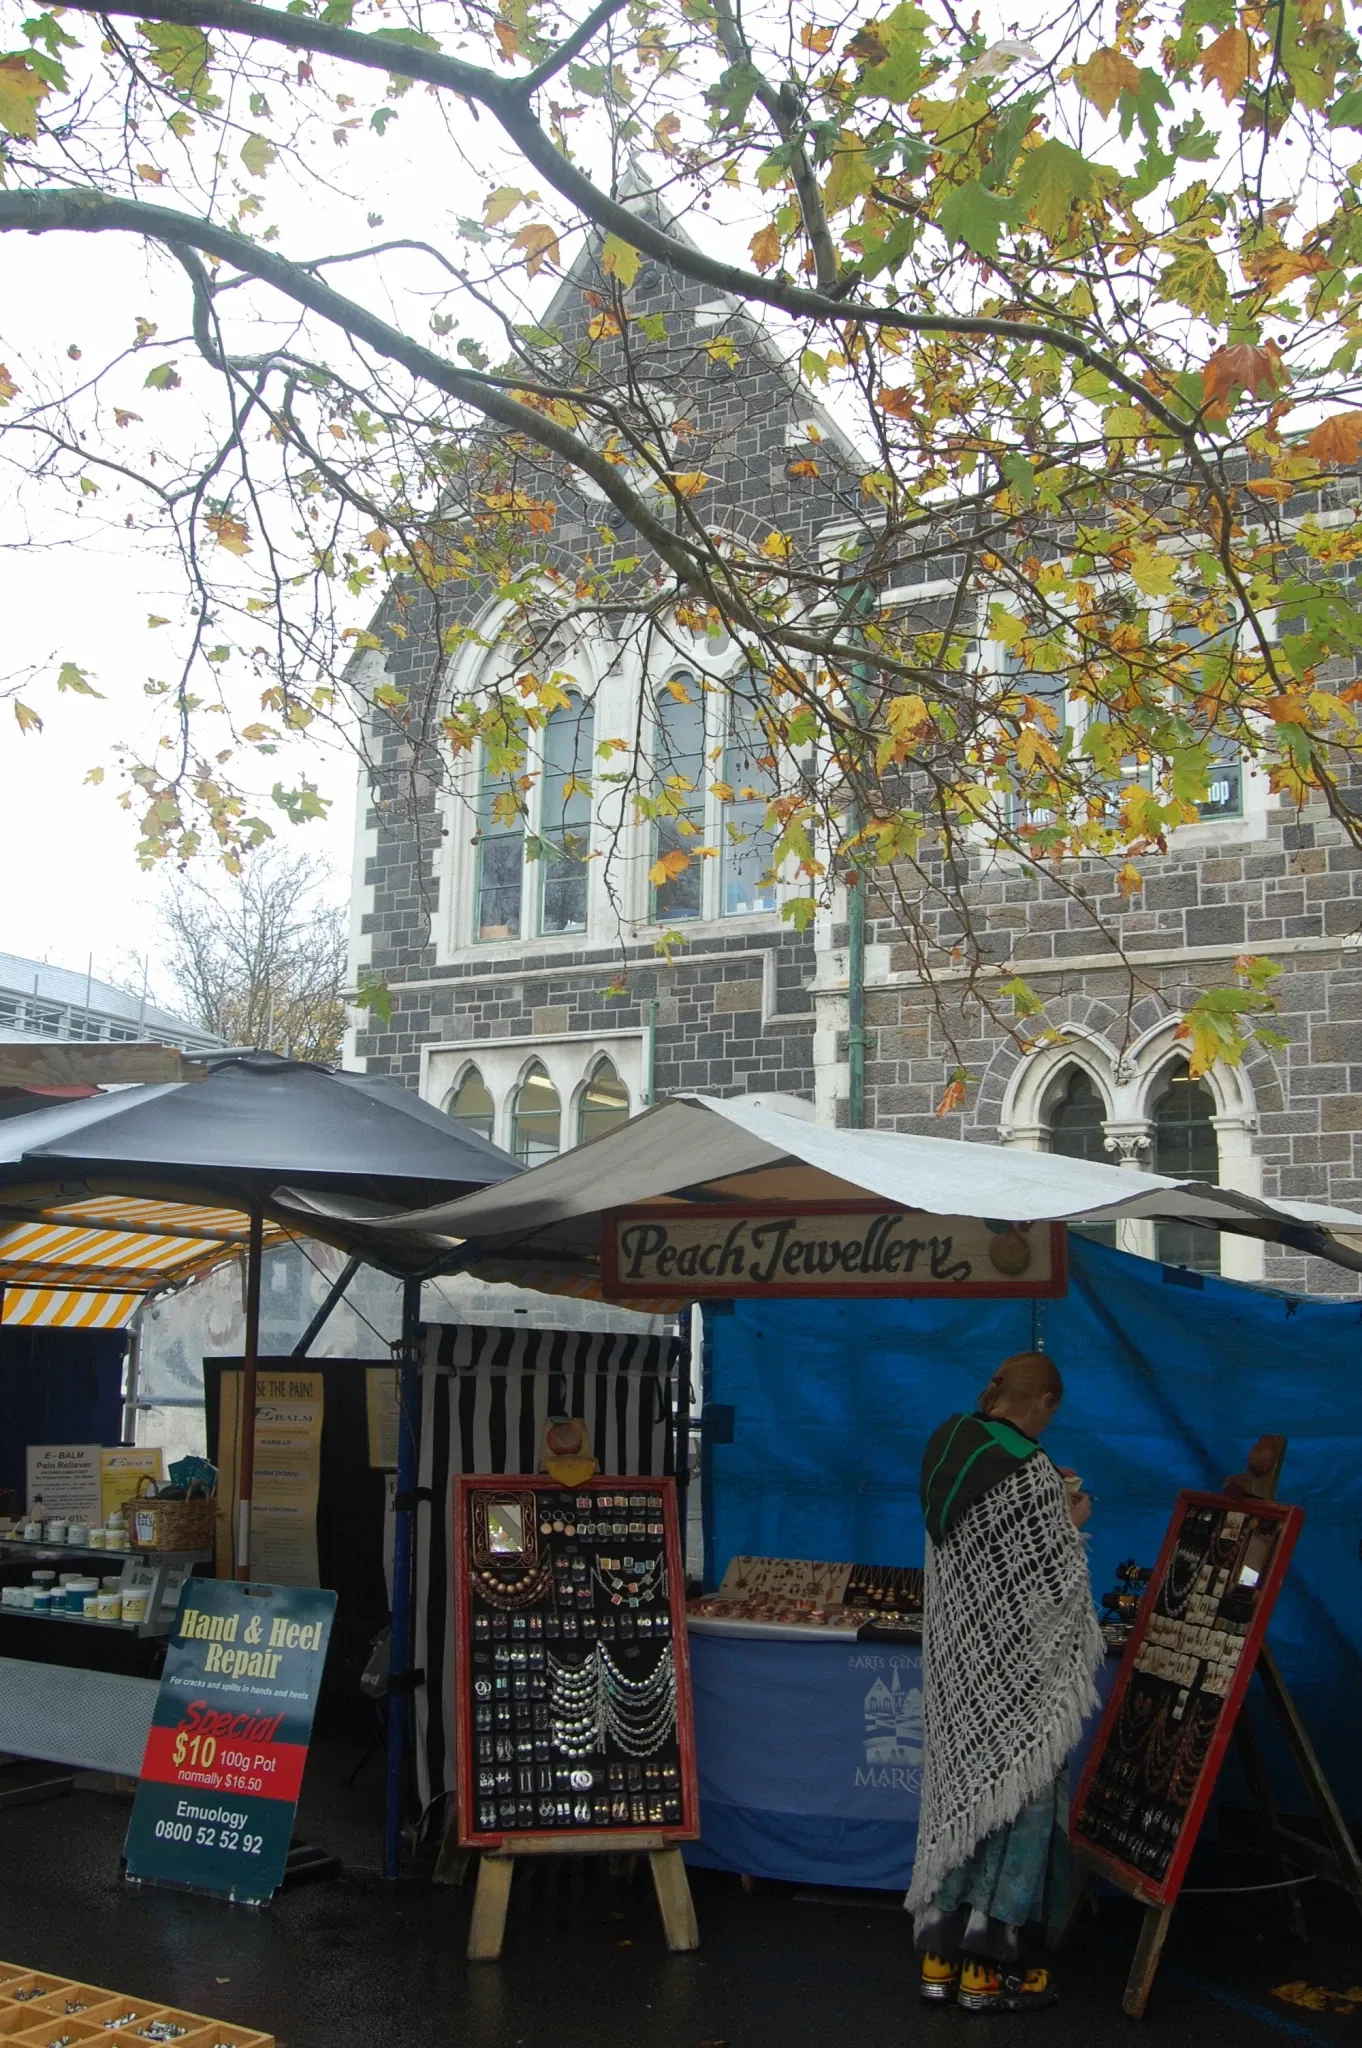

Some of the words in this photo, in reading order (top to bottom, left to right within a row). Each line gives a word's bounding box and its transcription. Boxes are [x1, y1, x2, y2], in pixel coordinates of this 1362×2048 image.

[621, 1219, 748, 1279] Peach
[748, 1214, 972, 1283] Jewellery
[268, 1381, 286, 1398] THE
[289, 1381, 313, 1398] PAIN!
[36, 1461, 56, 1469] Pain
[57, 1461, 93, 1469] Reliever
[44, 1452, 52, 1460] E
[58, 1451, 84, 1459] BALM
[178, 1609, 240, 1643] Hand
[243, 1615, 264, 1645] &
[268, 1617, 323, 1651] Heel
[204, 1643, 283, 1680] Repair
[169, 1676, 183, 1686] For
[183, 1677, 206, 1688] cracks
[206, 1680, 221, 1690] and
[221, 1681, 242, 1694] splits
[242, 1683, 250, 1693] in
[250, 1685, 273, 1696] hands
[273, 1688, 287, 1698] and
[289, 1690, 309, 1700] heels
[177, 1699, 287, 1743] Special
[172, 1730, 217, 1768] $10
[220, 1750, 251, 1773] 100g
[253, 1755, 277, 1773] Pot
[177, 1769, 223, 1789] normally
[224, 1773, 262, 1792] $16.50
[855, 1766, 923, 1795] MARK
[176, 1800, 249, 1830] Emuology
[155, 1820, 193, 1842] 0800
[195, 1826, 216, 1847] 52
[219, 1830, 240, 1851] 52
[242, 1834, 263, 1854] 92
